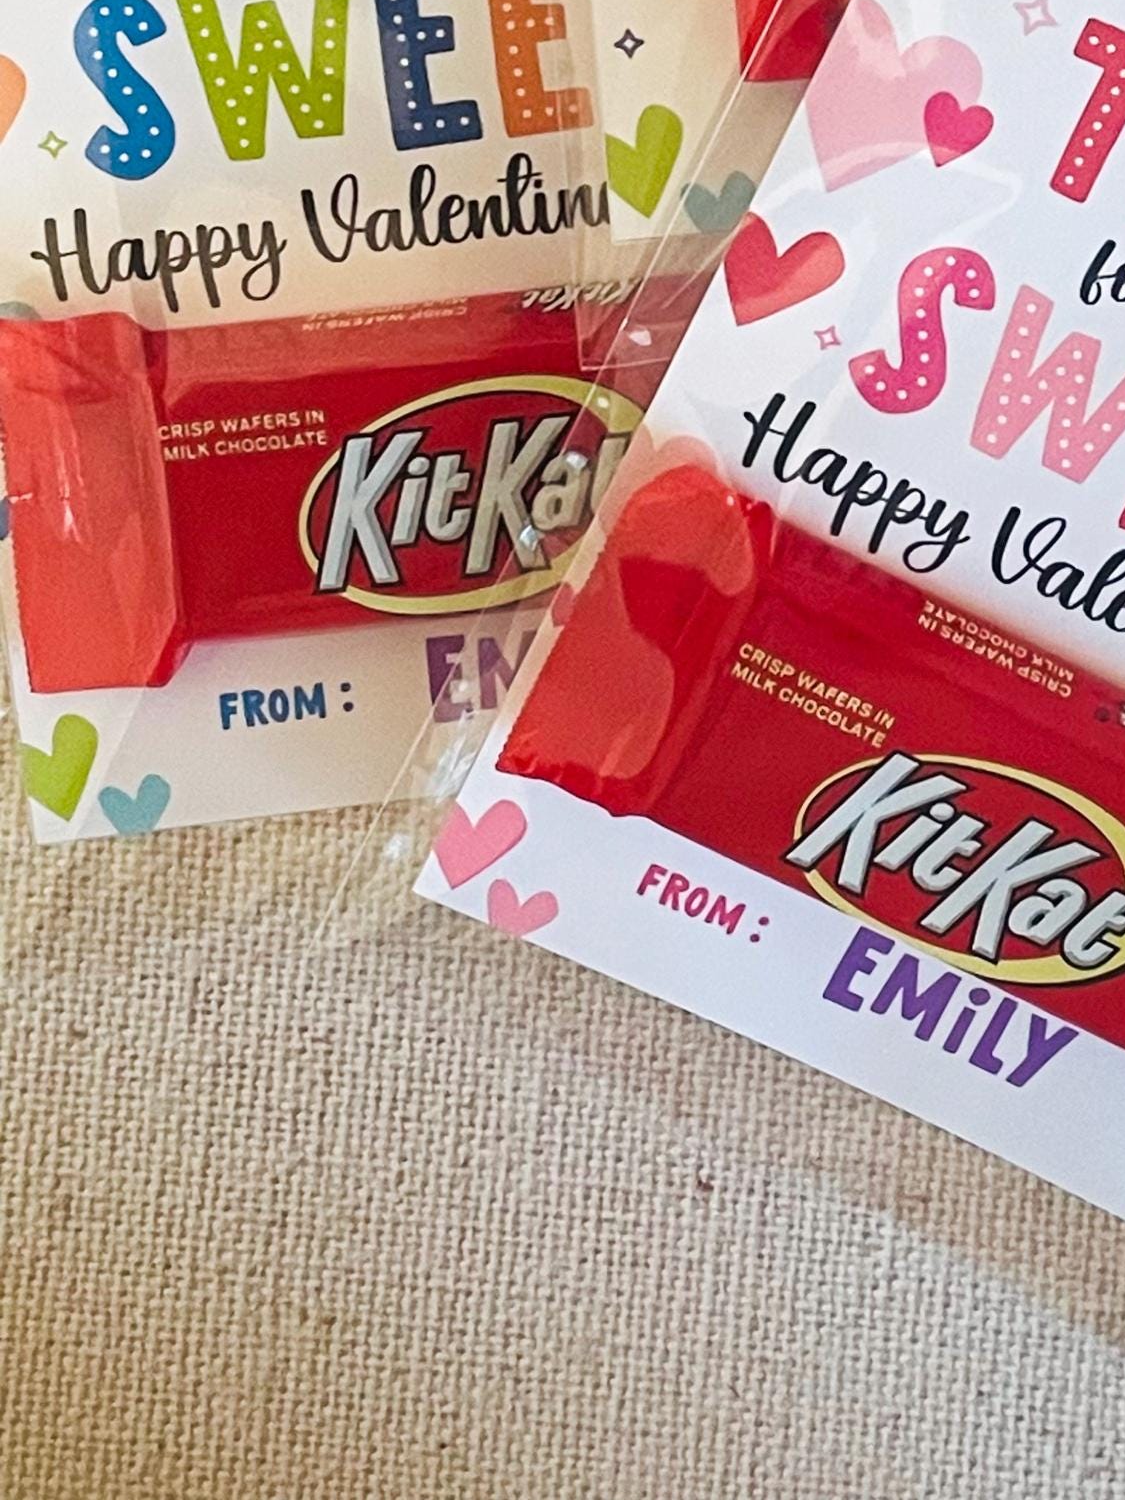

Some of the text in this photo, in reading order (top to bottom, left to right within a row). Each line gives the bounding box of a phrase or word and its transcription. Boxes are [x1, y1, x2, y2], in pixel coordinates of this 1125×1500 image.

[30, 151, 610, 314] Happy Valentin
[157, 409, 325, 441] CRISP WAFERS IN
[162, 429, 328, 462] MILK CHOCOLATE
[741, 391, 971, 574] Happy
[917, 614, 1073, 698] CRISP WAFERS IN
[922, 600, 1075, 683] MILK CHOCOLATE
[730, 661, 887, 749] MILK CHOCOLATE
[738, 642, 896, 730] CRISP WAFERS IN
